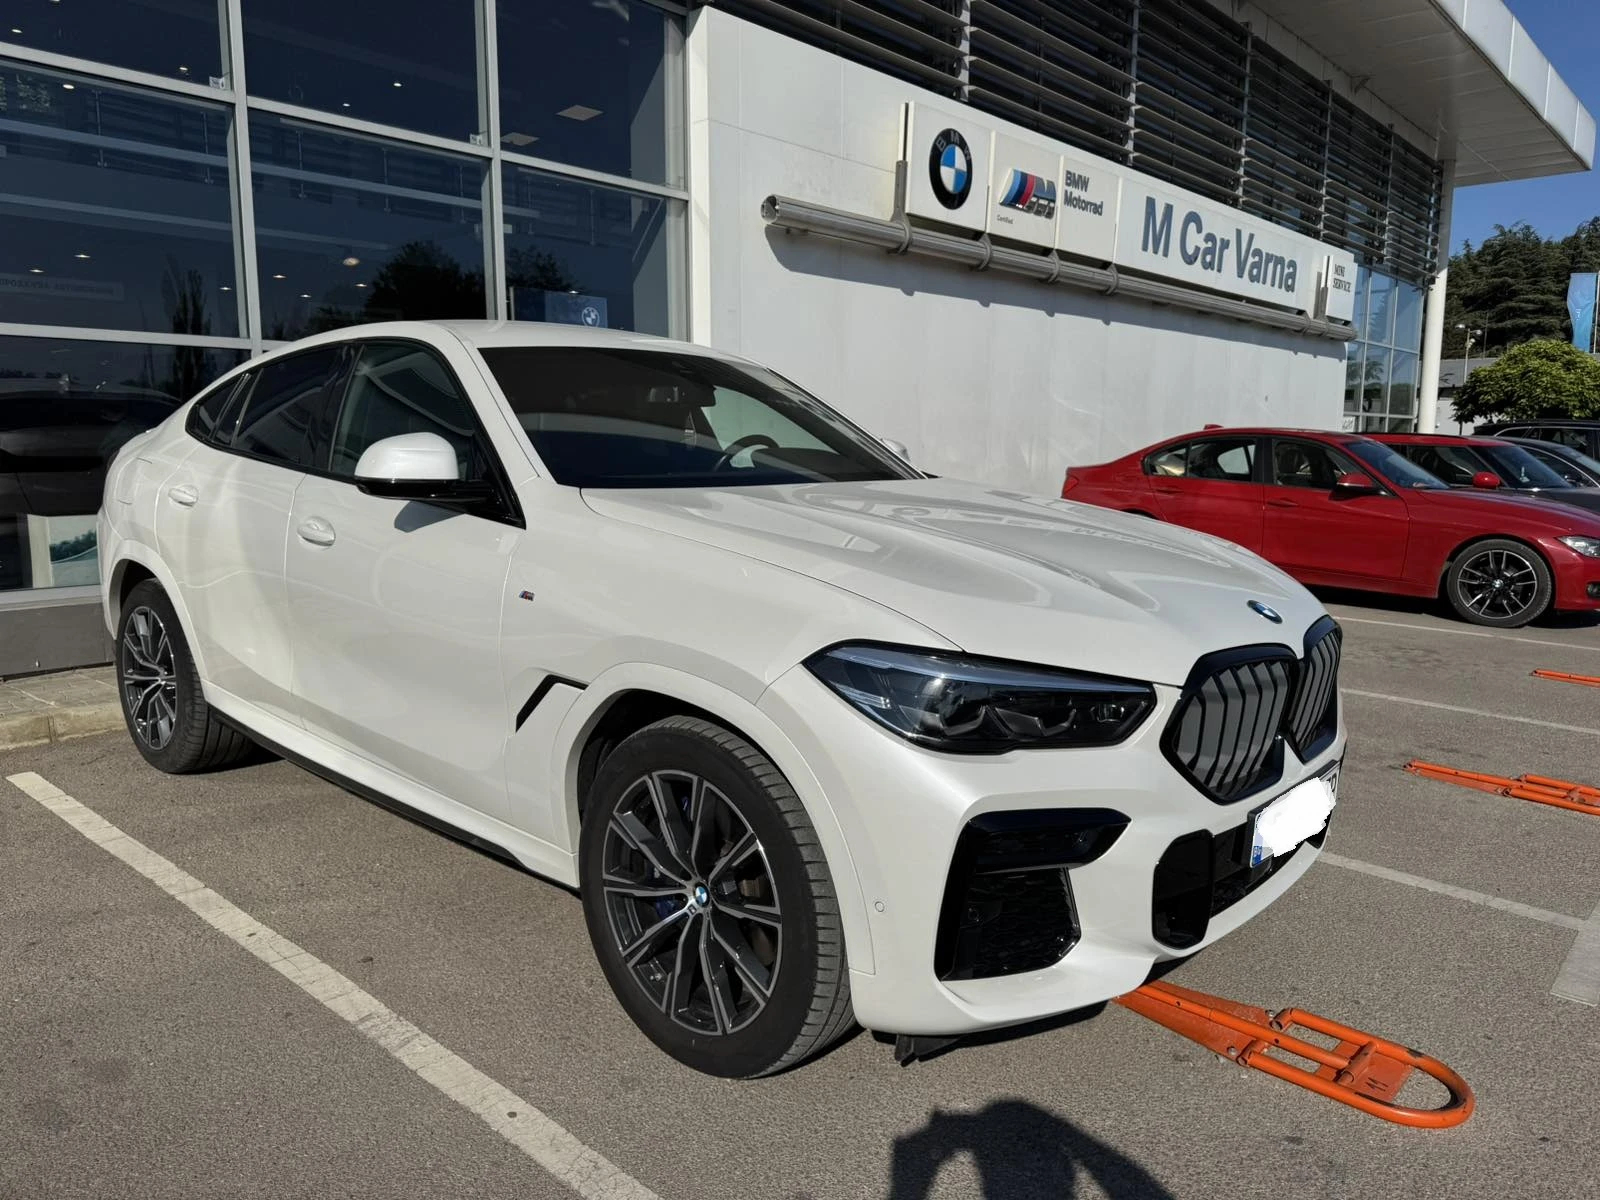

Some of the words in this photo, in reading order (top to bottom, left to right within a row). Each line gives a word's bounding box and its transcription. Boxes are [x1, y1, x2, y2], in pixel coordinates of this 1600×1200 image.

[1065, 169, 1090, 193] BMW
[1064, 189, 1104, 216] Motorrad
[1141, 196, 1174, 258] M
[1179, 210, 1230, 273] Car
[1235, 228, 1298, 293] Varna
[1334, 263, 1346, 277] MINI
[1333, 277, 1352, 293] SERVICE
